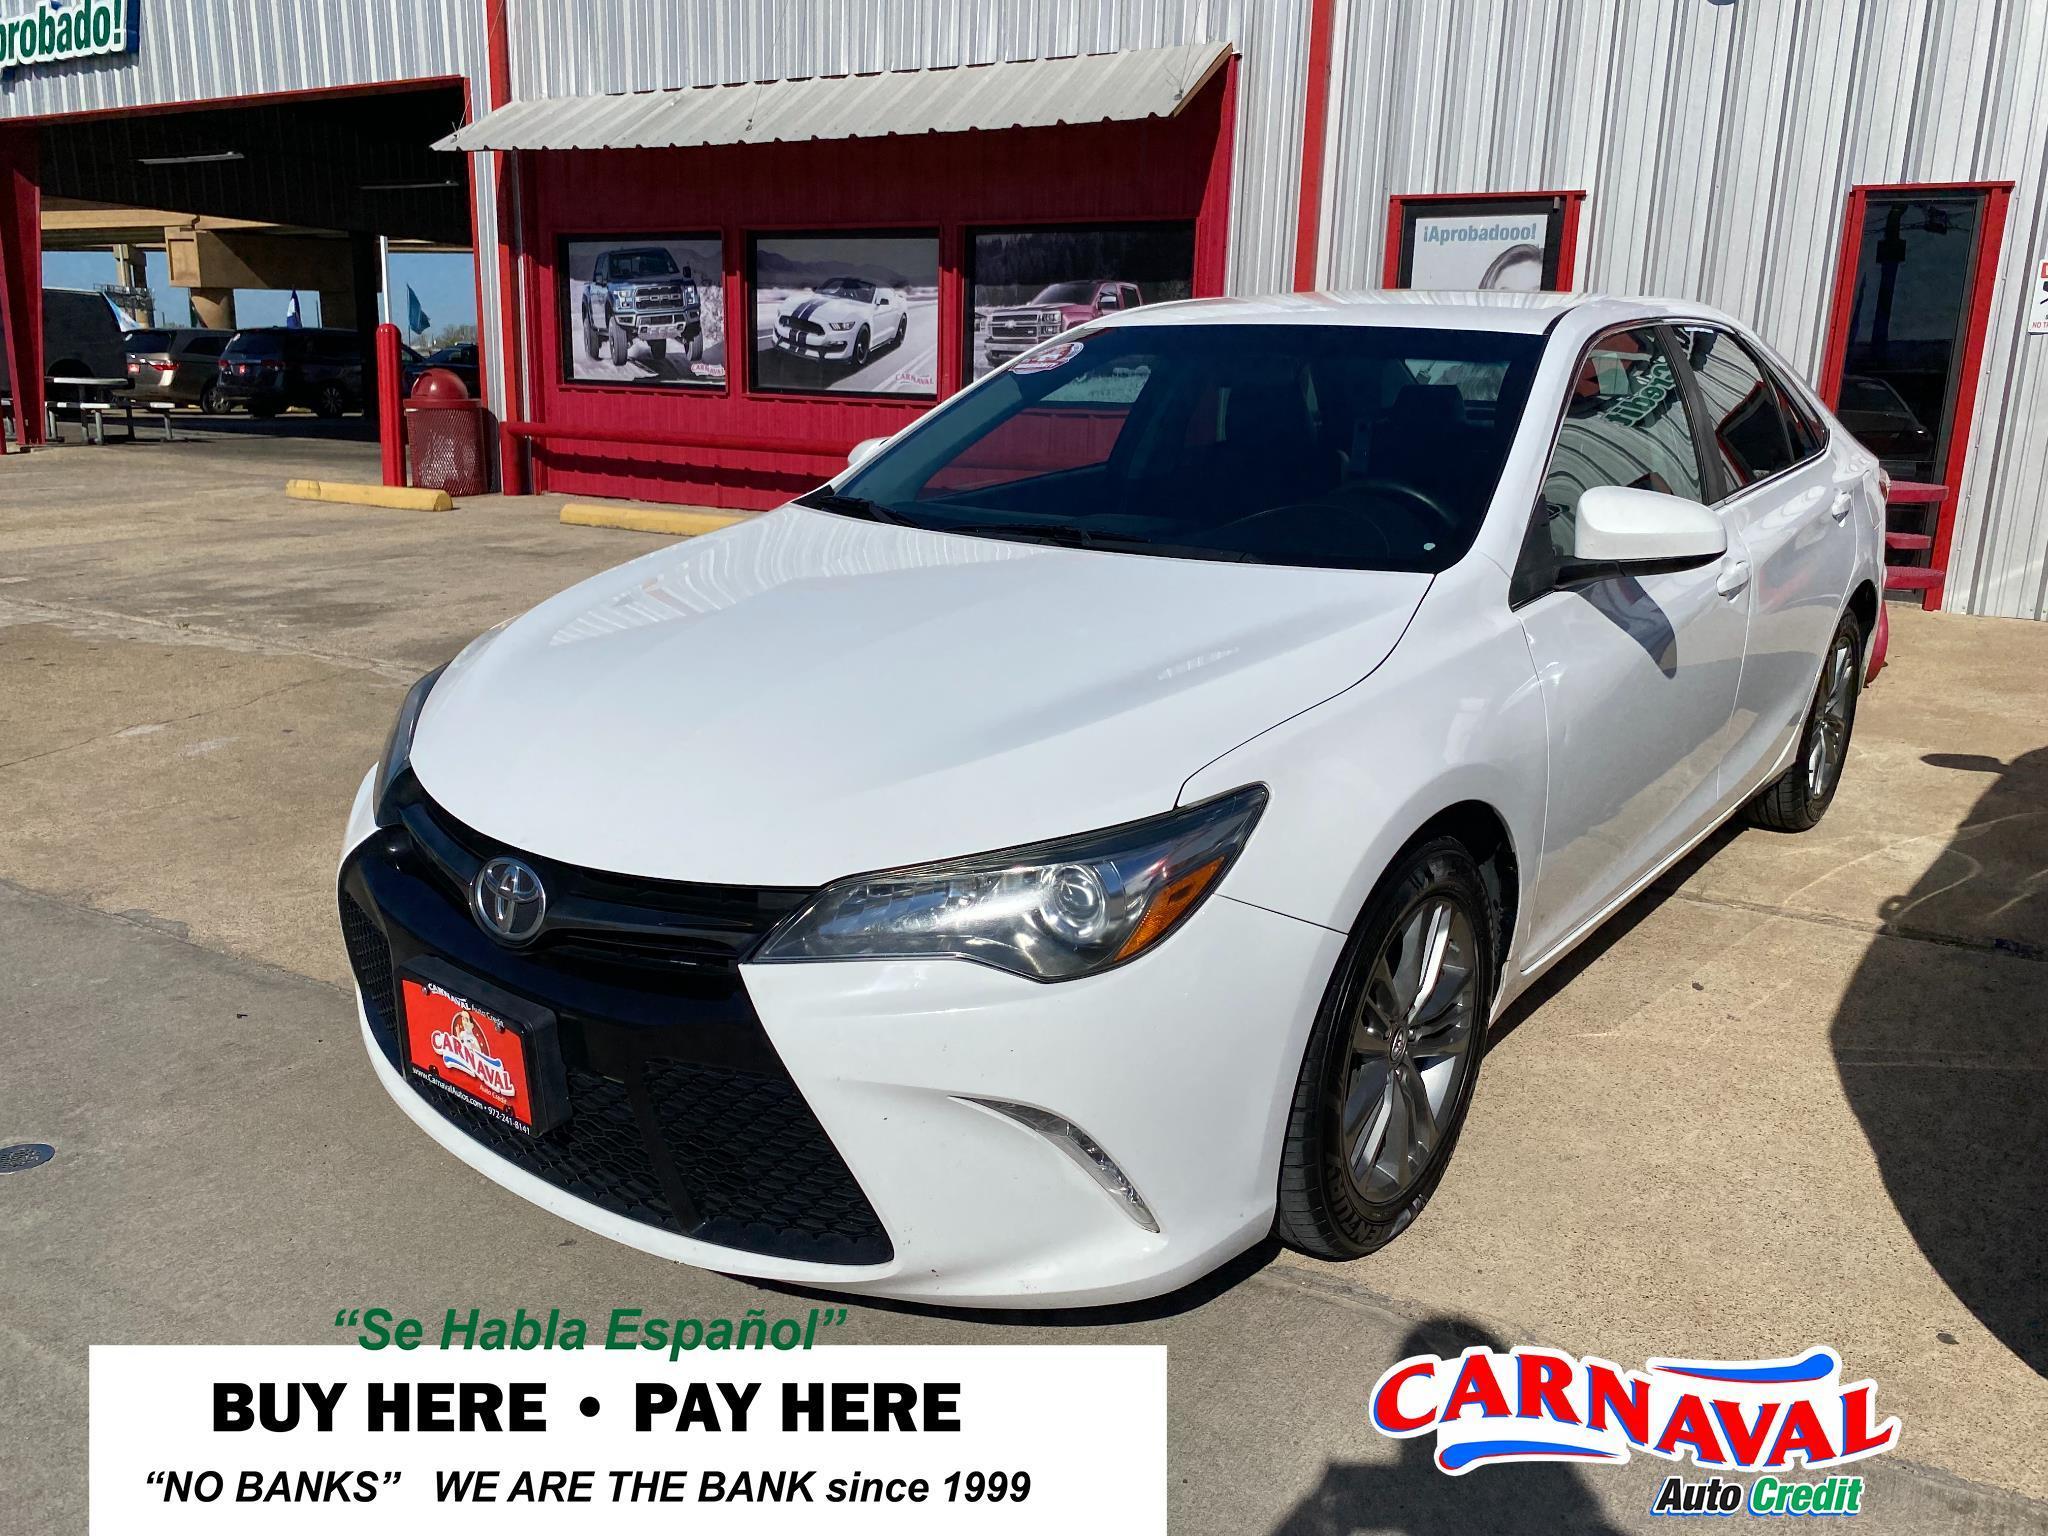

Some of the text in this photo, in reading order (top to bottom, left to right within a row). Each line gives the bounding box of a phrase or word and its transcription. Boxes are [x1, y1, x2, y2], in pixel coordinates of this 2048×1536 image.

[1423, 222, 1537, 246] ¡Aprobadooo!
[635, 292, 681, 303] FORD
[895, 372, 935, 385] CARNAVAL
[432, 1032, 514, 1092] CARNAVAL
[412, 1066, 530, 1136] www.CarnavalAutos.com 972-241-8141
